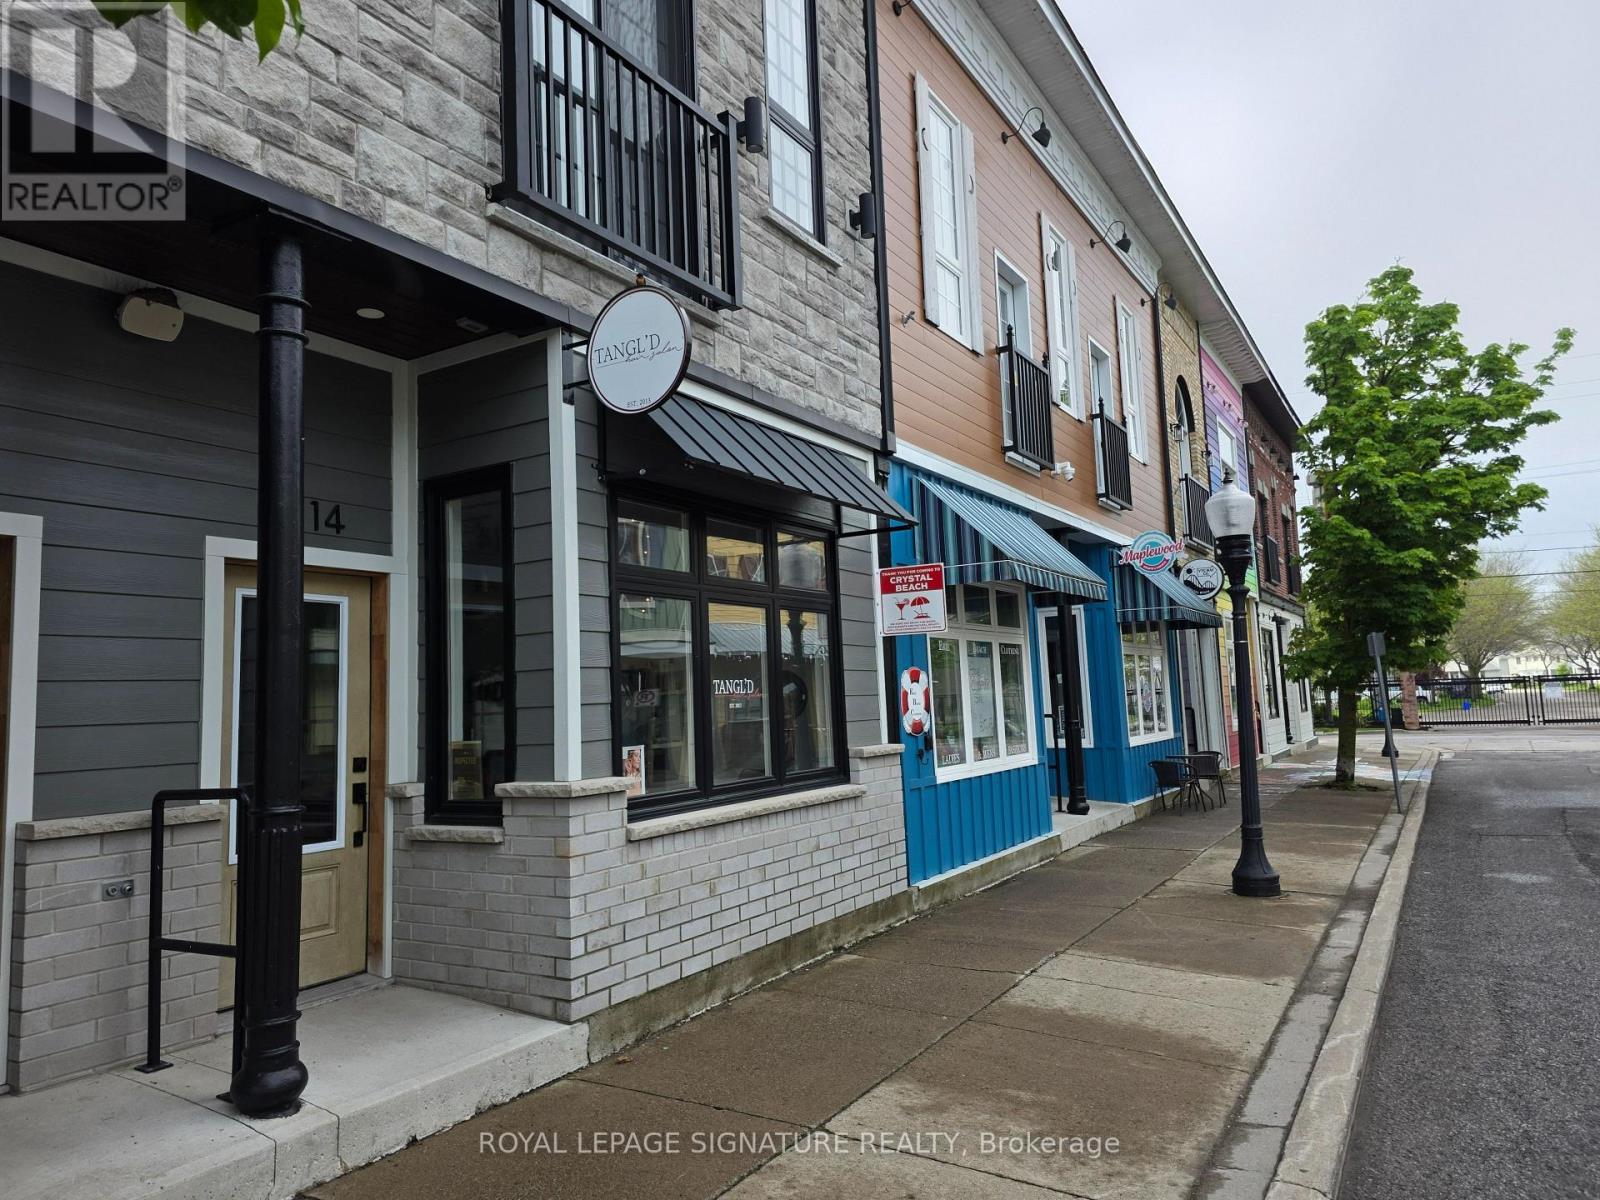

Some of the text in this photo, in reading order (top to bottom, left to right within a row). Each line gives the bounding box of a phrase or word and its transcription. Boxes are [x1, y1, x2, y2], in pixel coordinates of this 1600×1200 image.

[594, 333, 661, 364] TANGL'D
[309, 500, 346, 535] 14
[1119, 537, 1185, 564] Maplewood
[889, 574, 933, 584] CRYSTAL
[895, 582, 928, 592] BEACH
[713, 678, 754, 695] TANGL'D
